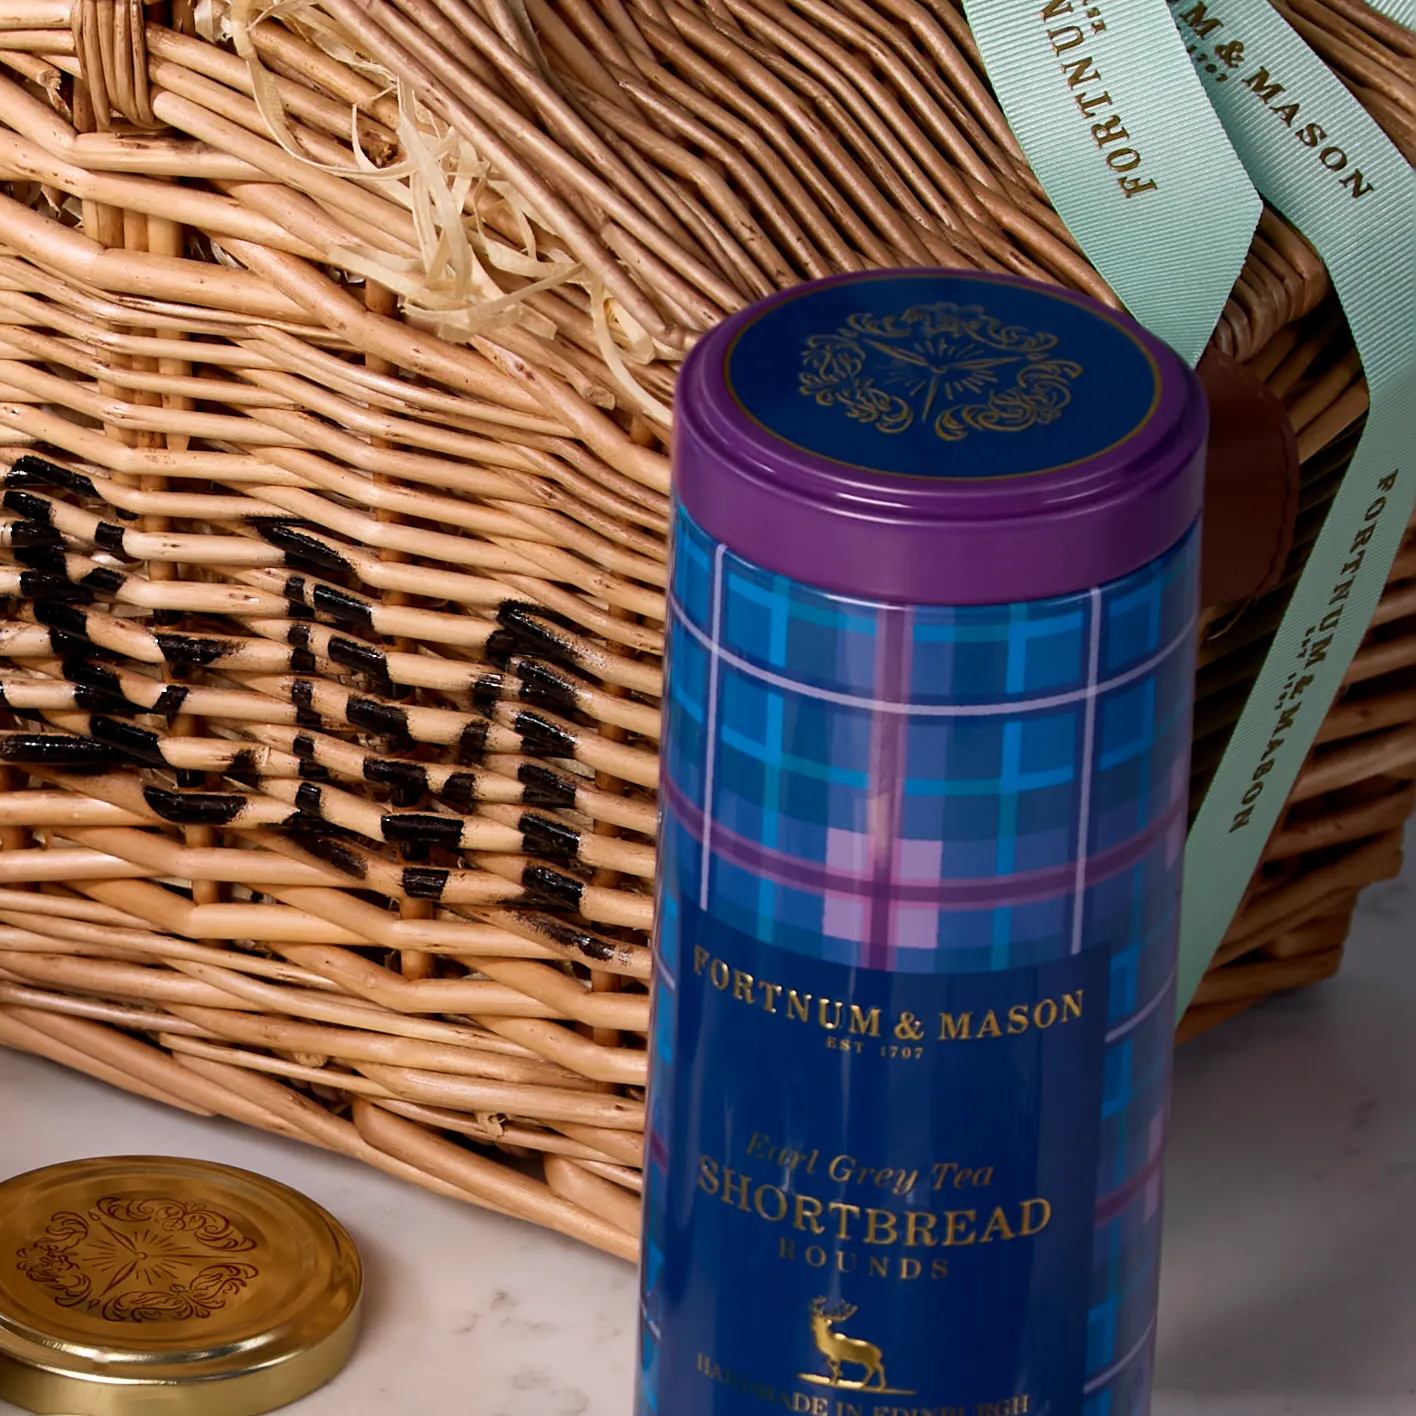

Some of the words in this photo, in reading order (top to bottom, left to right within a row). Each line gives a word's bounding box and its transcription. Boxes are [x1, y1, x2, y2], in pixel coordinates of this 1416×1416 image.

[1214, 40, 1245, 69] &
[1241, 65, 1375, 199] MASON
[1303, 468, 1399, 670] FORTNUM
[1290, 674, 1315, 700] &
[1229, 701, 1302, 833] MASON
[693, 944, 882, 1038] FORTNUM
[894, 1012, 925, 1041] &
[937, 989, 1085, 1041] MASON
[826, 1036, 863, 1054] EST
[880, 1045, 924, 1059] 1707
[697, 1154, 1052, 1247] SHORTBREAD
[745, 1131, 820, 1174] Earl
[827, 1154, 918, 1195] Grey
[932, 1162, 995, 1190] Tea
[778, 1236, 949, 1280] ROUNDS
